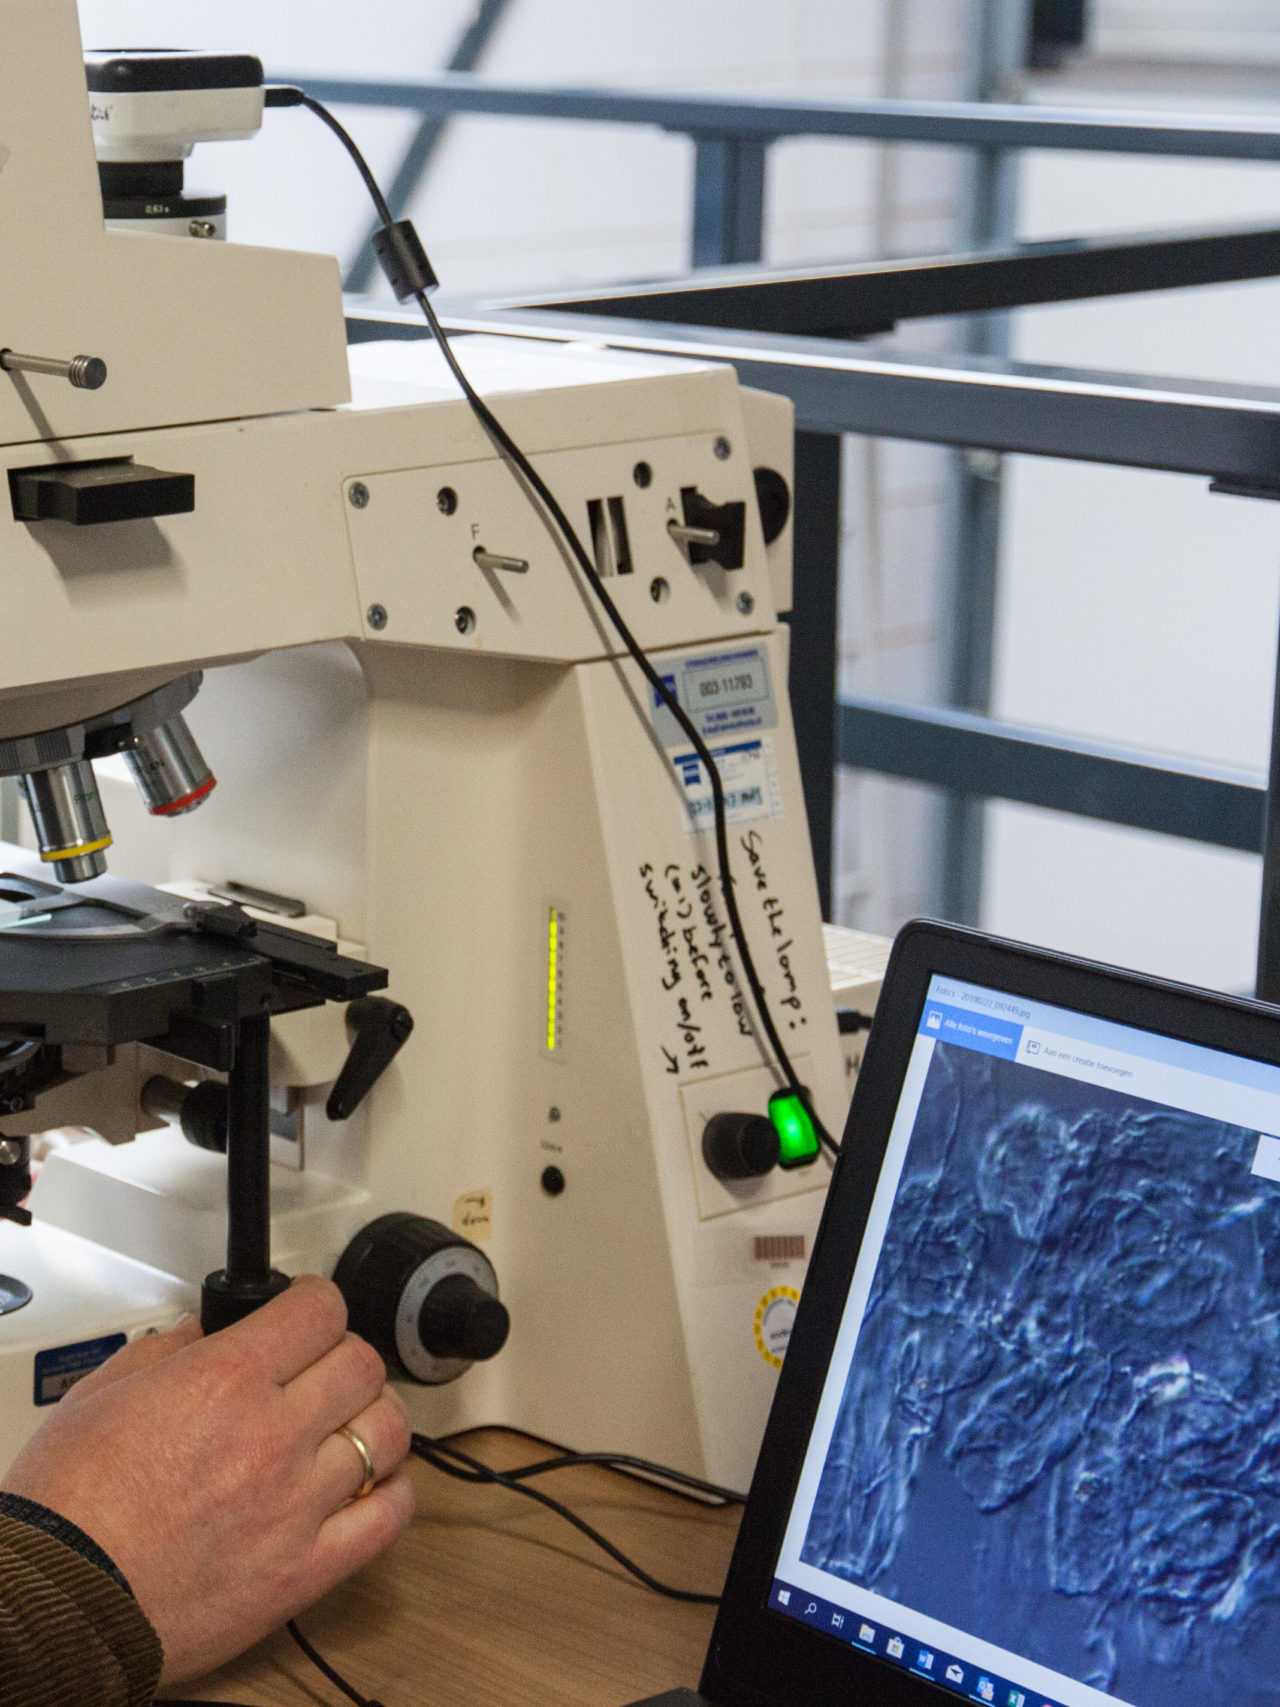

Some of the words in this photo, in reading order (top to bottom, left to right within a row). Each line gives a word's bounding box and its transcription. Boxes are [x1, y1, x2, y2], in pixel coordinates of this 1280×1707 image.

[666, 495, 677, 513] A
[471, 523, 480, 540] F
[741, 830, 769, 891] Save
[763, 897, 784, 937] the
[639, 863, 682, 992] switching
[676, 997, 710, 1070] on/off
[682, 925, 714, 1001] before
[691, 864, 728, 949] slowly
[717, 954, 735, 986] to
[730, 992, 754, 1037] low
[976, 1029, 1013, 1046] weergeven
[1043, 1046, 1058, 1057] Aan
[1058, 1052, 1072, 1061] een
[1072, 1055, 1096, 1069] creatie
[1096, 1061, 1134, 1078] toevoegen
